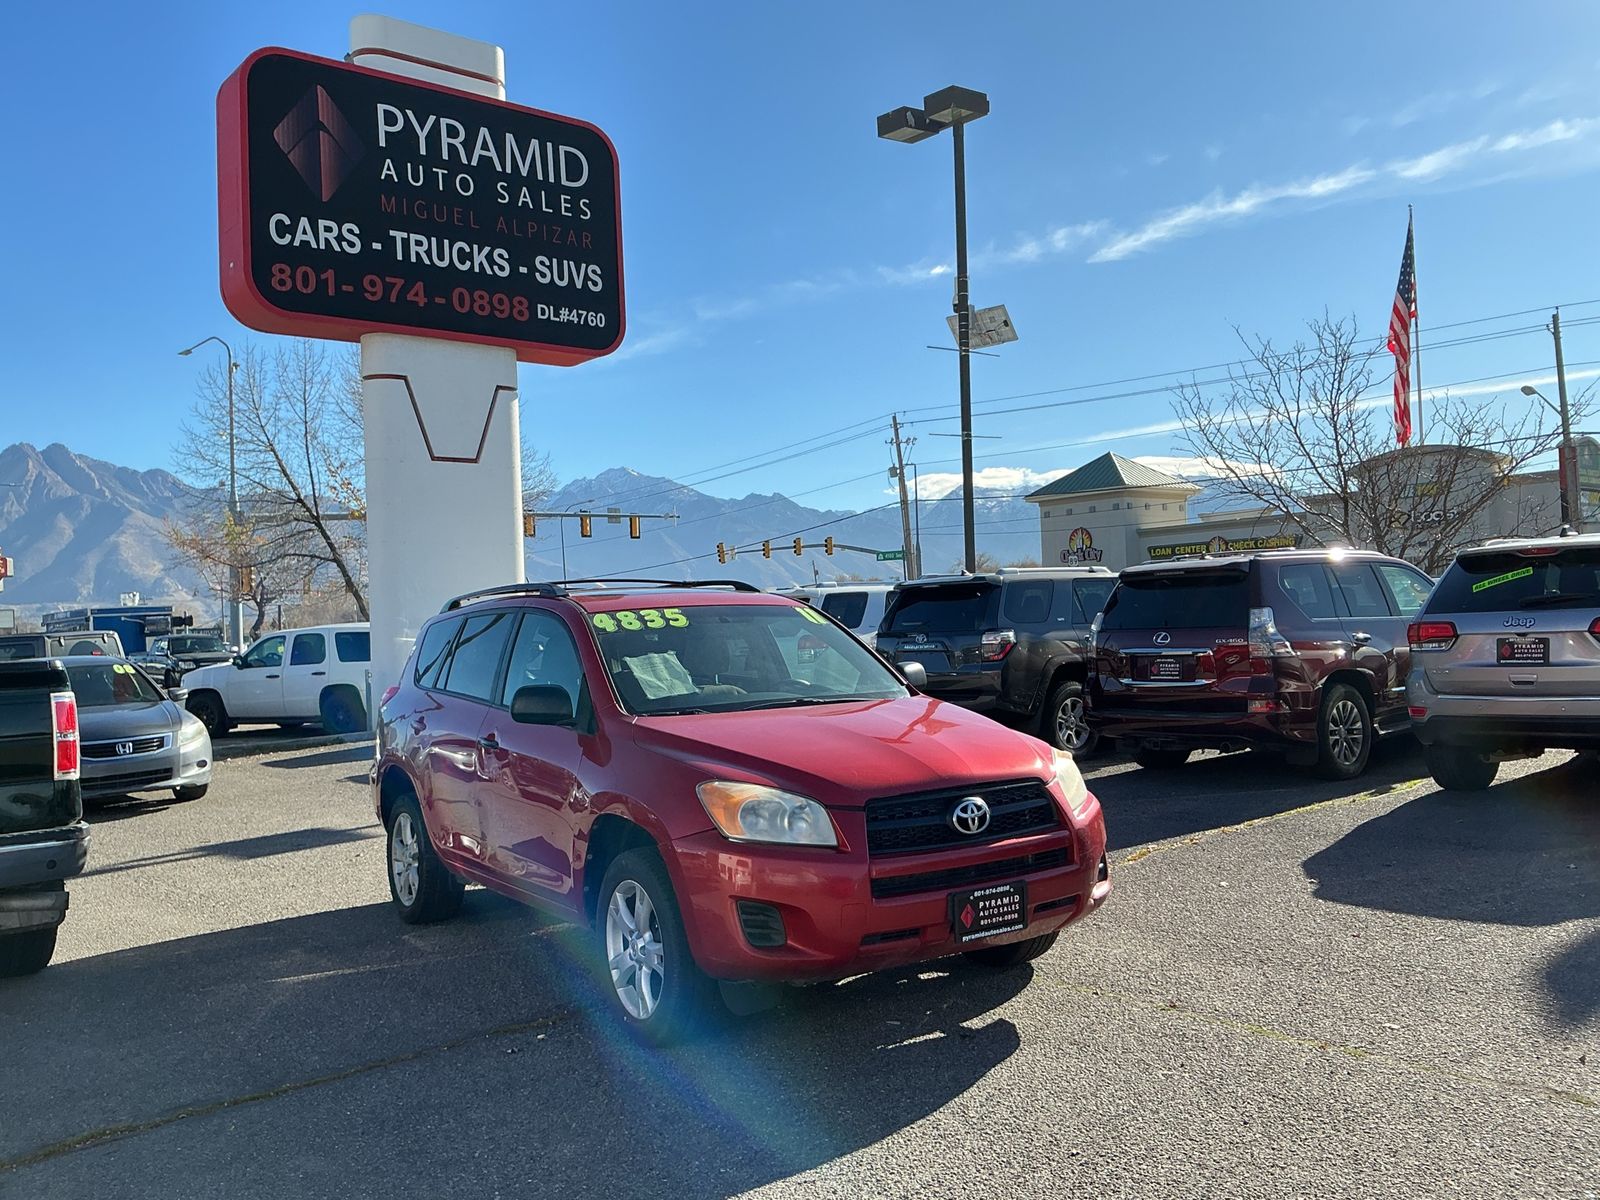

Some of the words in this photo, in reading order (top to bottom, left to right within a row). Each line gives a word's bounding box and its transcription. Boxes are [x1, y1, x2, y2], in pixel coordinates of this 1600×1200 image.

[376, 103, 590, 188] PYRAMID
[380, 158, 475, 196] AUTO
[496, 181, 592, 220] SALES
[380, 194, 480, 229] MIGUEL
[496, 215, 593, 249] ALPIZAR
[269, 212, 362, 255] CARS
[389, 229, 511, 278] TRUCKS
[535, 255, 603, 292] SUVS
[536, 303, 606, 328] DL#4760
[1150, 548, 1172, 556] LOAN
[1175, 544, 1207, 555] CENTER
[1227, 541, 1256, 551] CHECK
[1510, 567, 1532, 578] DRIVE
[593, 608, 690, 632] 4835
[1503, 616, 1535, 628] Jeep
[979, 895, 1020, 909] PYRAMID
[979, 908, 998, 917] AUTO
[999, 903, 1020, 912] SALES
[962, 924, 1023, 942] pyramidautosales.com
